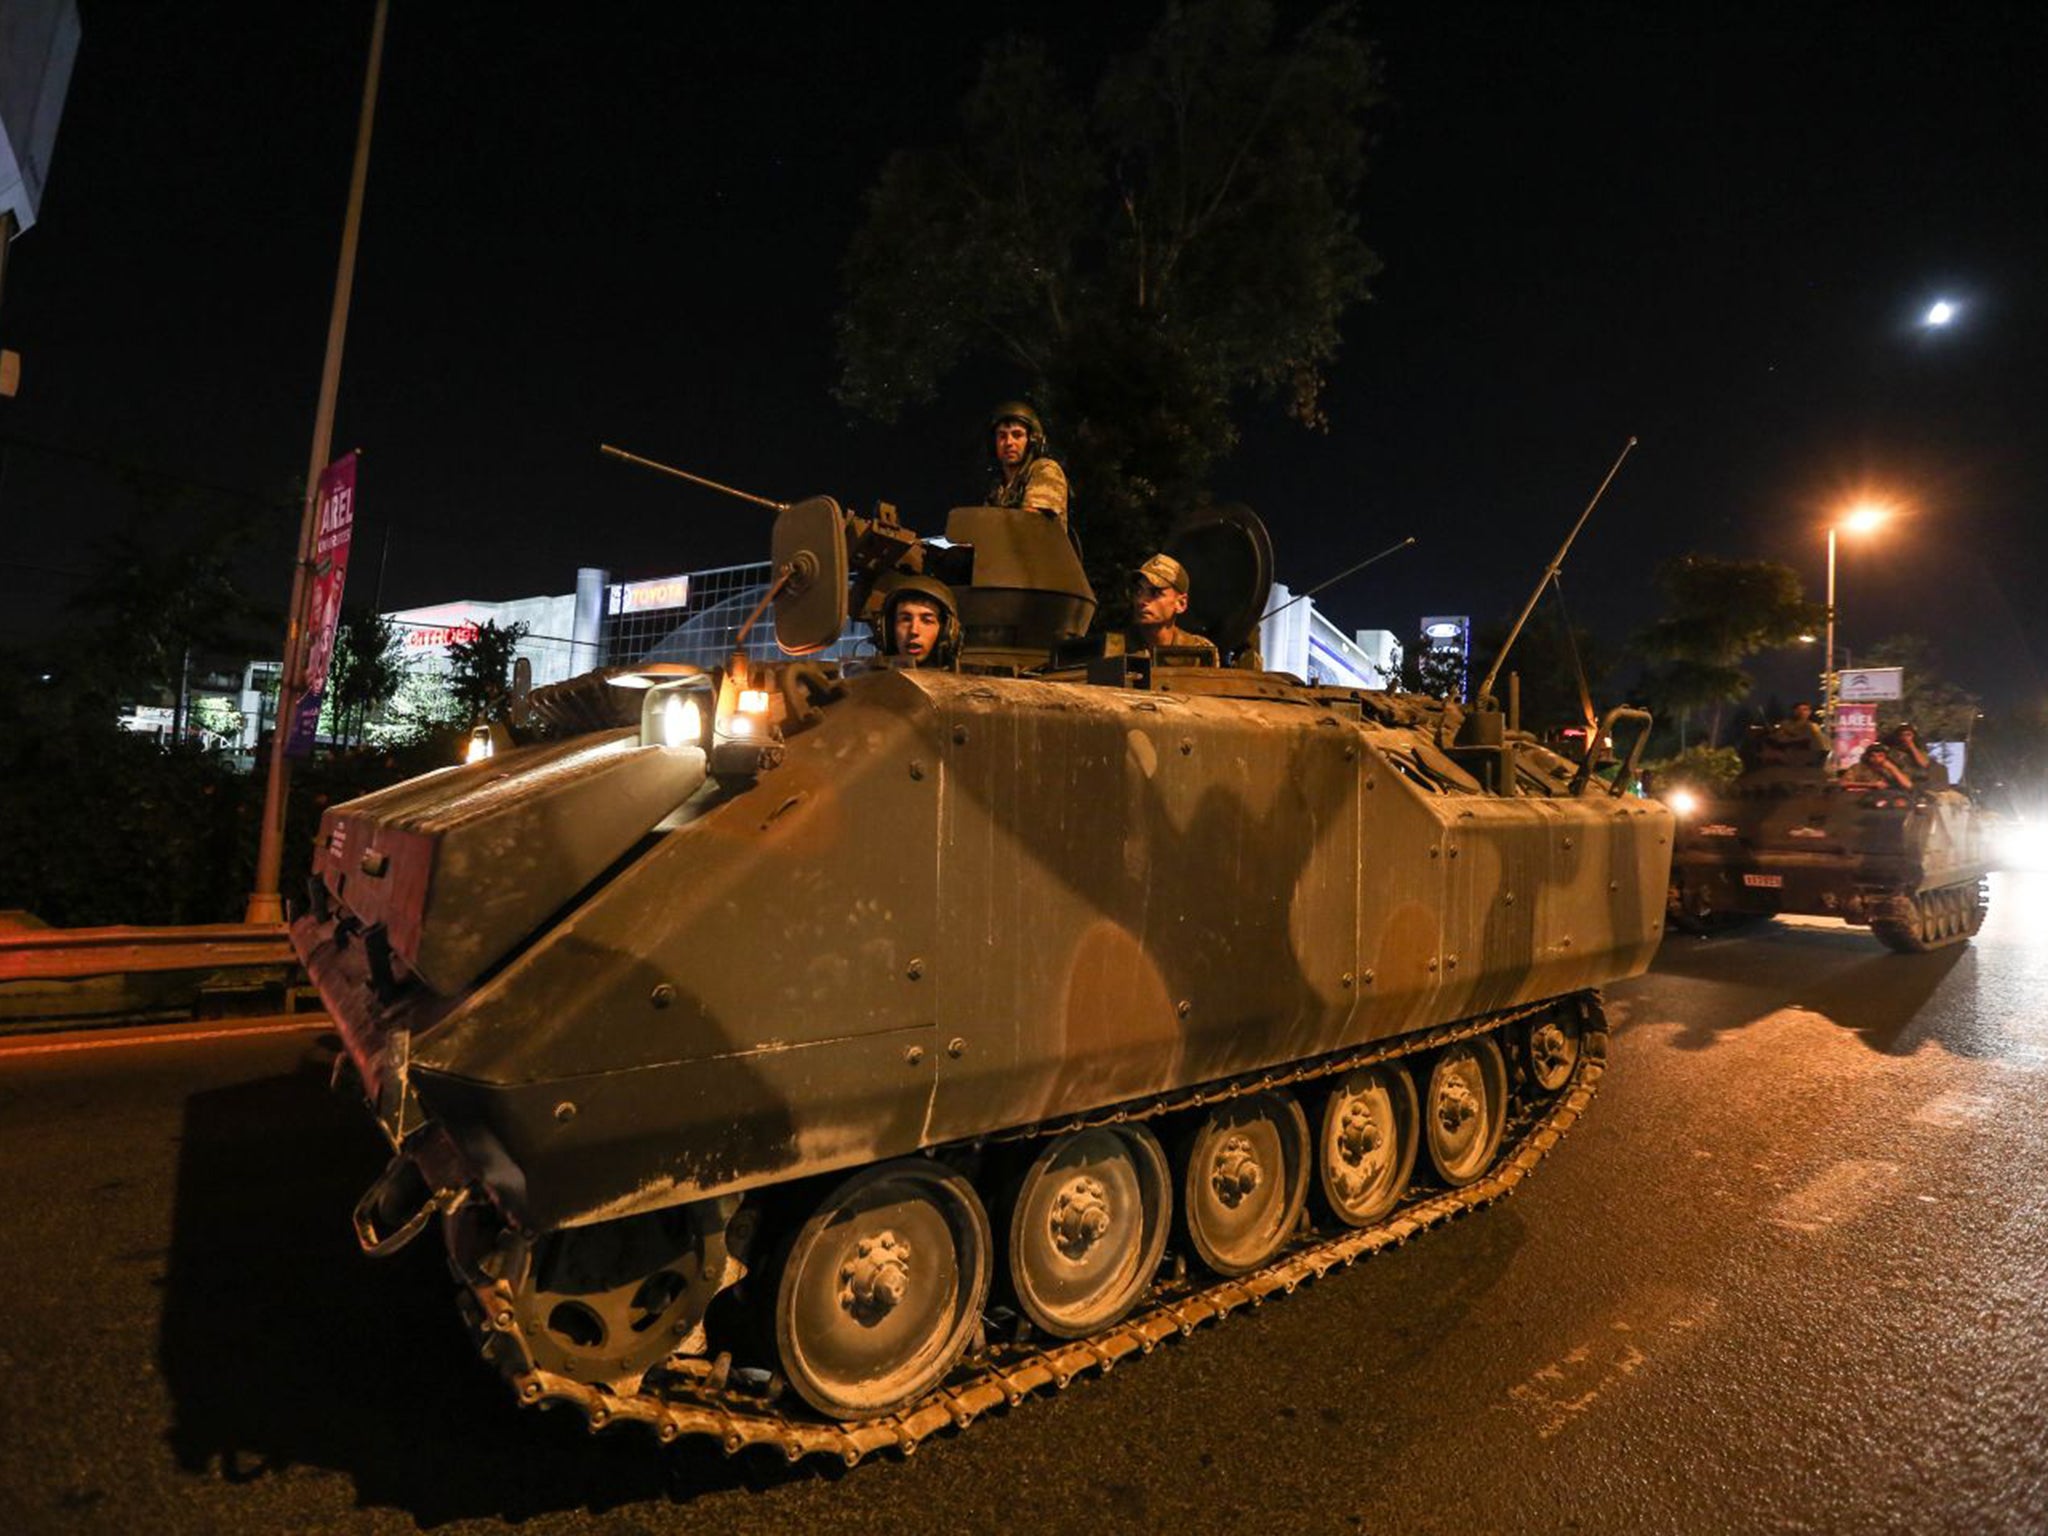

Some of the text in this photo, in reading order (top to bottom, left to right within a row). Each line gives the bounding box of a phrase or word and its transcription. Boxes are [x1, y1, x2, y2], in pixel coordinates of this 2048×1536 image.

[320, 487, 353, 536] AREL
[632, 584, 685, 606] TOYOTA
[1839, 713, 1877, 726] AREL
